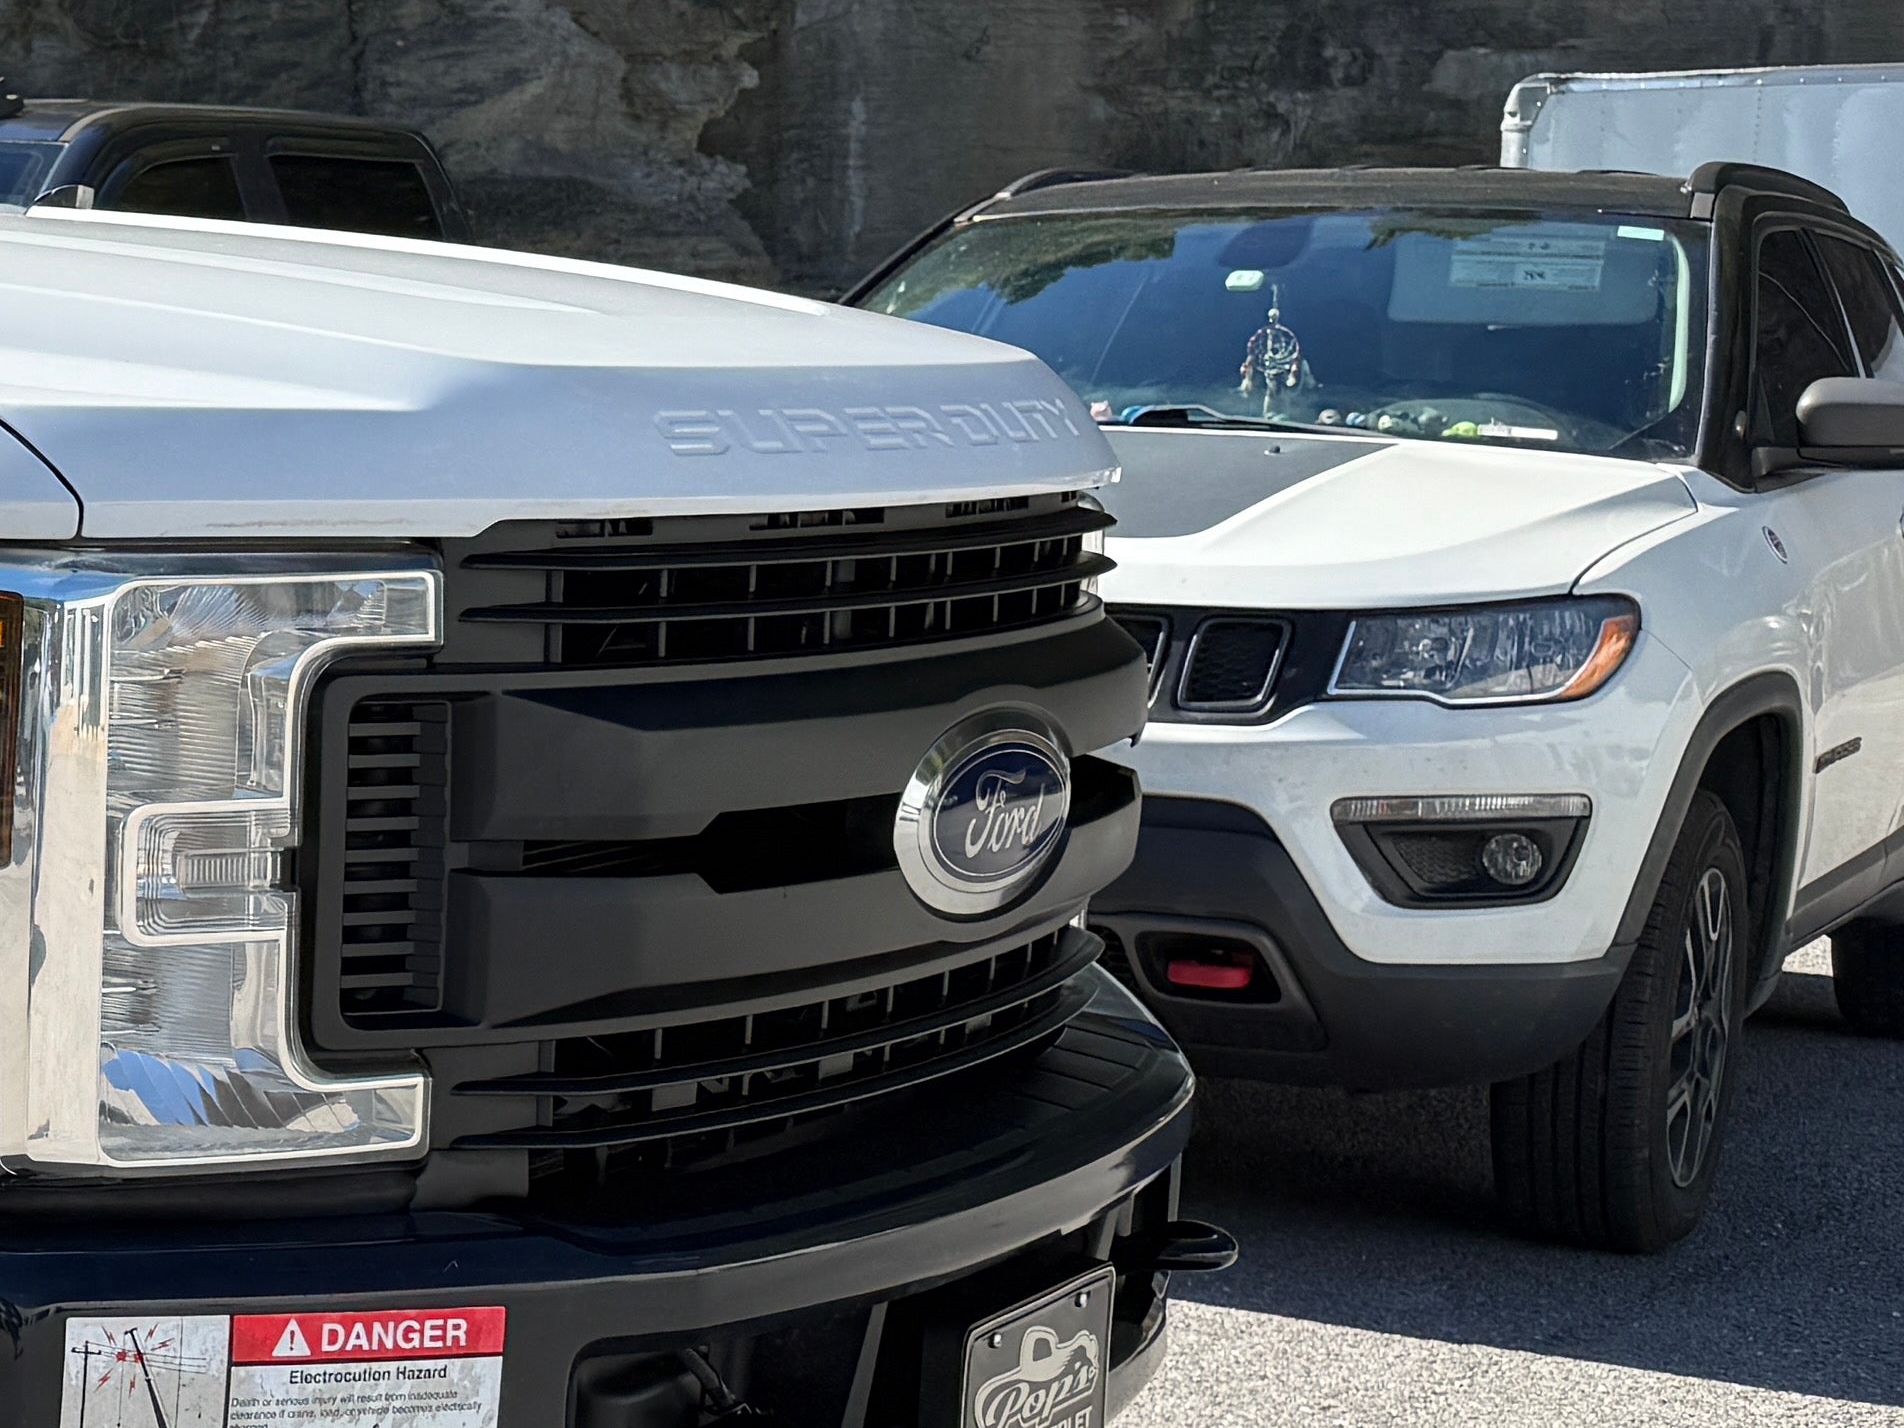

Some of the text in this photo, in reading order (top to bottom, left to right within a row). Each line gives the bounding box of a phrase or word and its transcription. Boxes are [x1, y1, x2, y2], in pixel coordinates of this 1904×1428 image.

[965, 768, 1046, 859] Ford
[321, 1318, 468, 1353] DANGER
[289, 1364, 448, 1384] Electrocution Hazard
